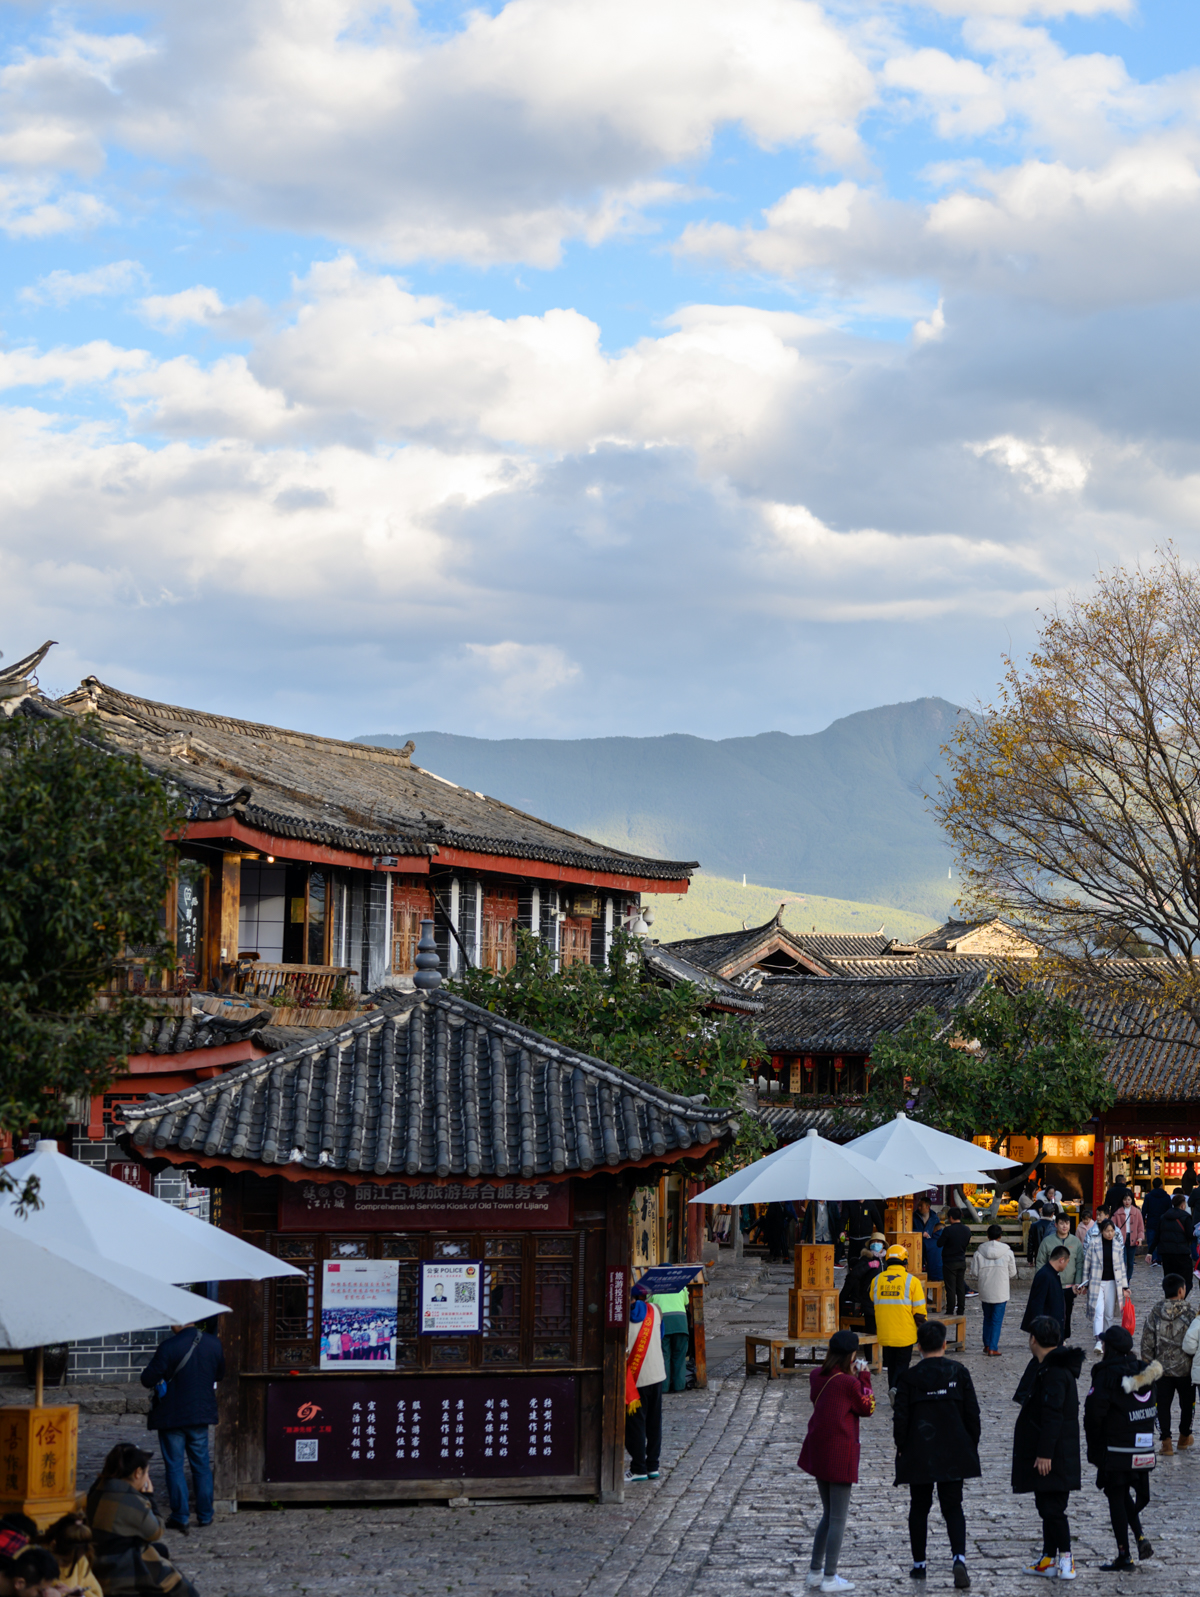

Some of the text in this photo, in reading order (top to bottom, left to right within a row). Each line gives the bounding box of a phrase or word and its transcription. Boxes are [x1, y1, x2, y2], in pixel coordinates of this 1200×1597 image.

[355, 1184, 550, 1200] 丽江古城旅游综合服务亭
[354, 1202, 549, 1211] Comprehensive Service Kiosk of Old Town of Lijiang
[36, 1420, 62, 1488] 俭养德
